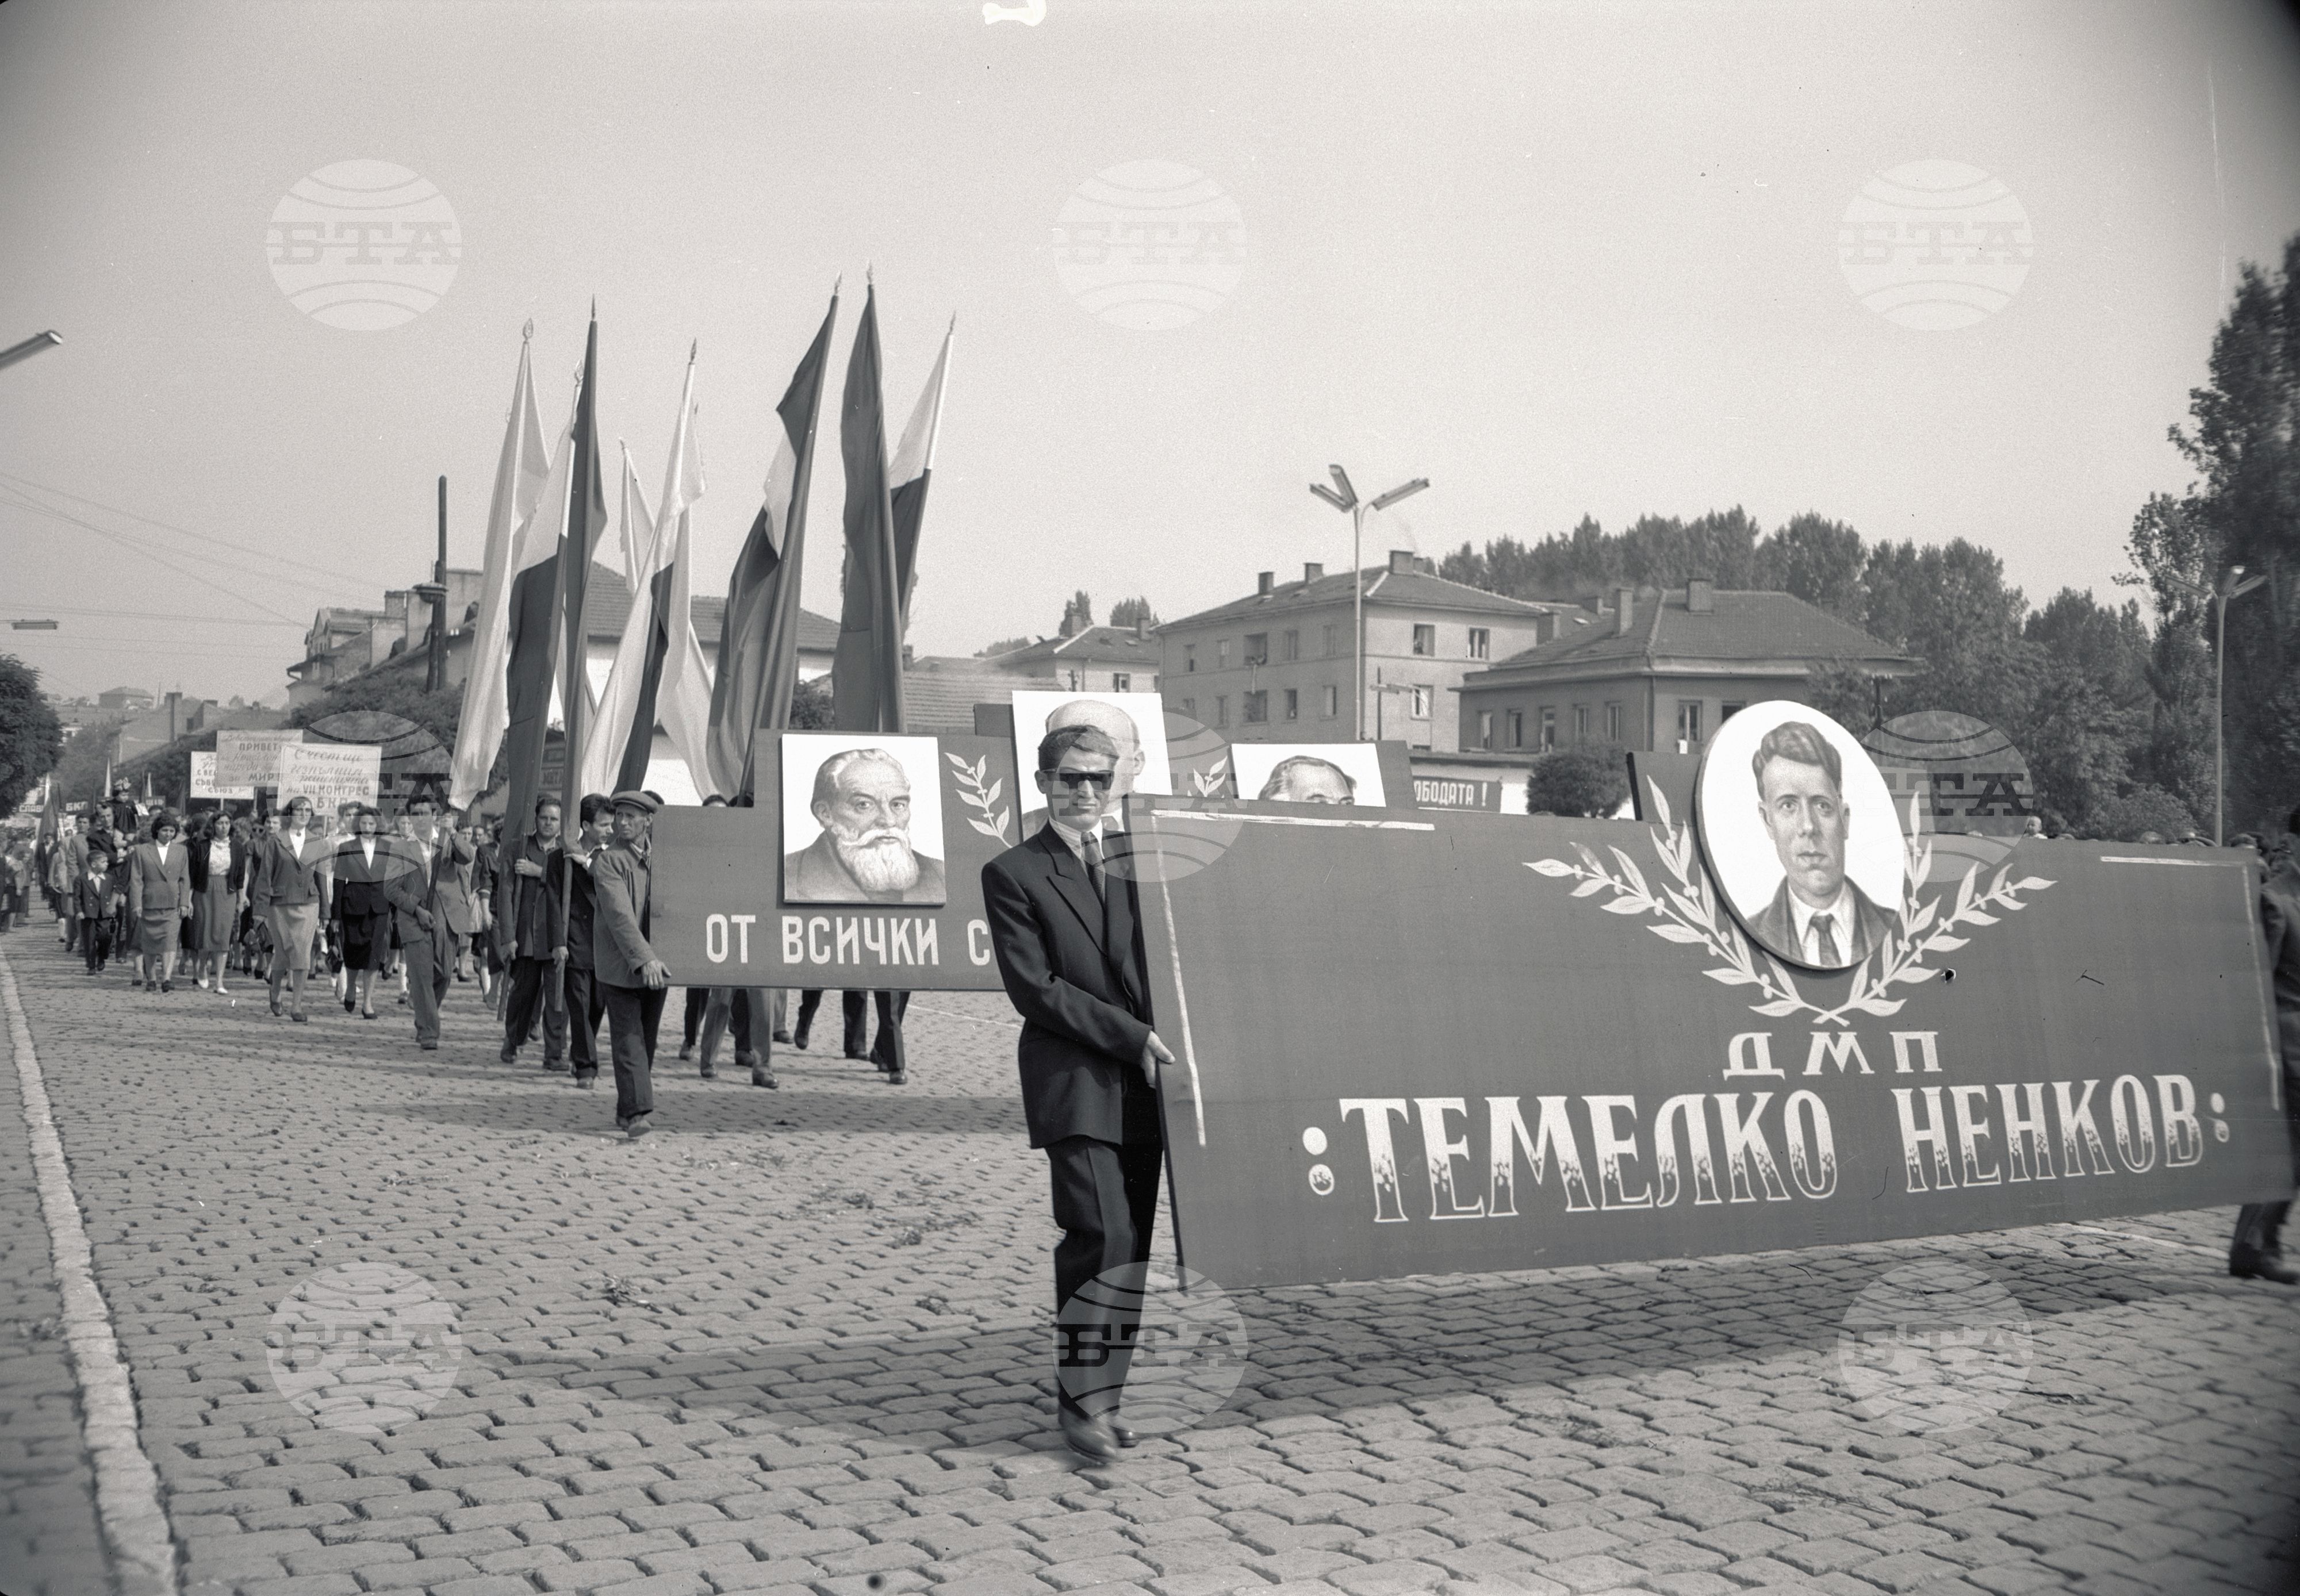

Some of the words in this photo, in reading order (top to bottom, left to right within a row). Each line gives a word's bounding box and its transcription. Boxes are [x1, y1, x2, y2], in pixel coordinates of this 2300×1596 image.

[318, 785, 369, 796] КОНГРЕС
[706, 914, 756, 964] ОТ
[782, 915, 940, 965] ВСИЧКИ
